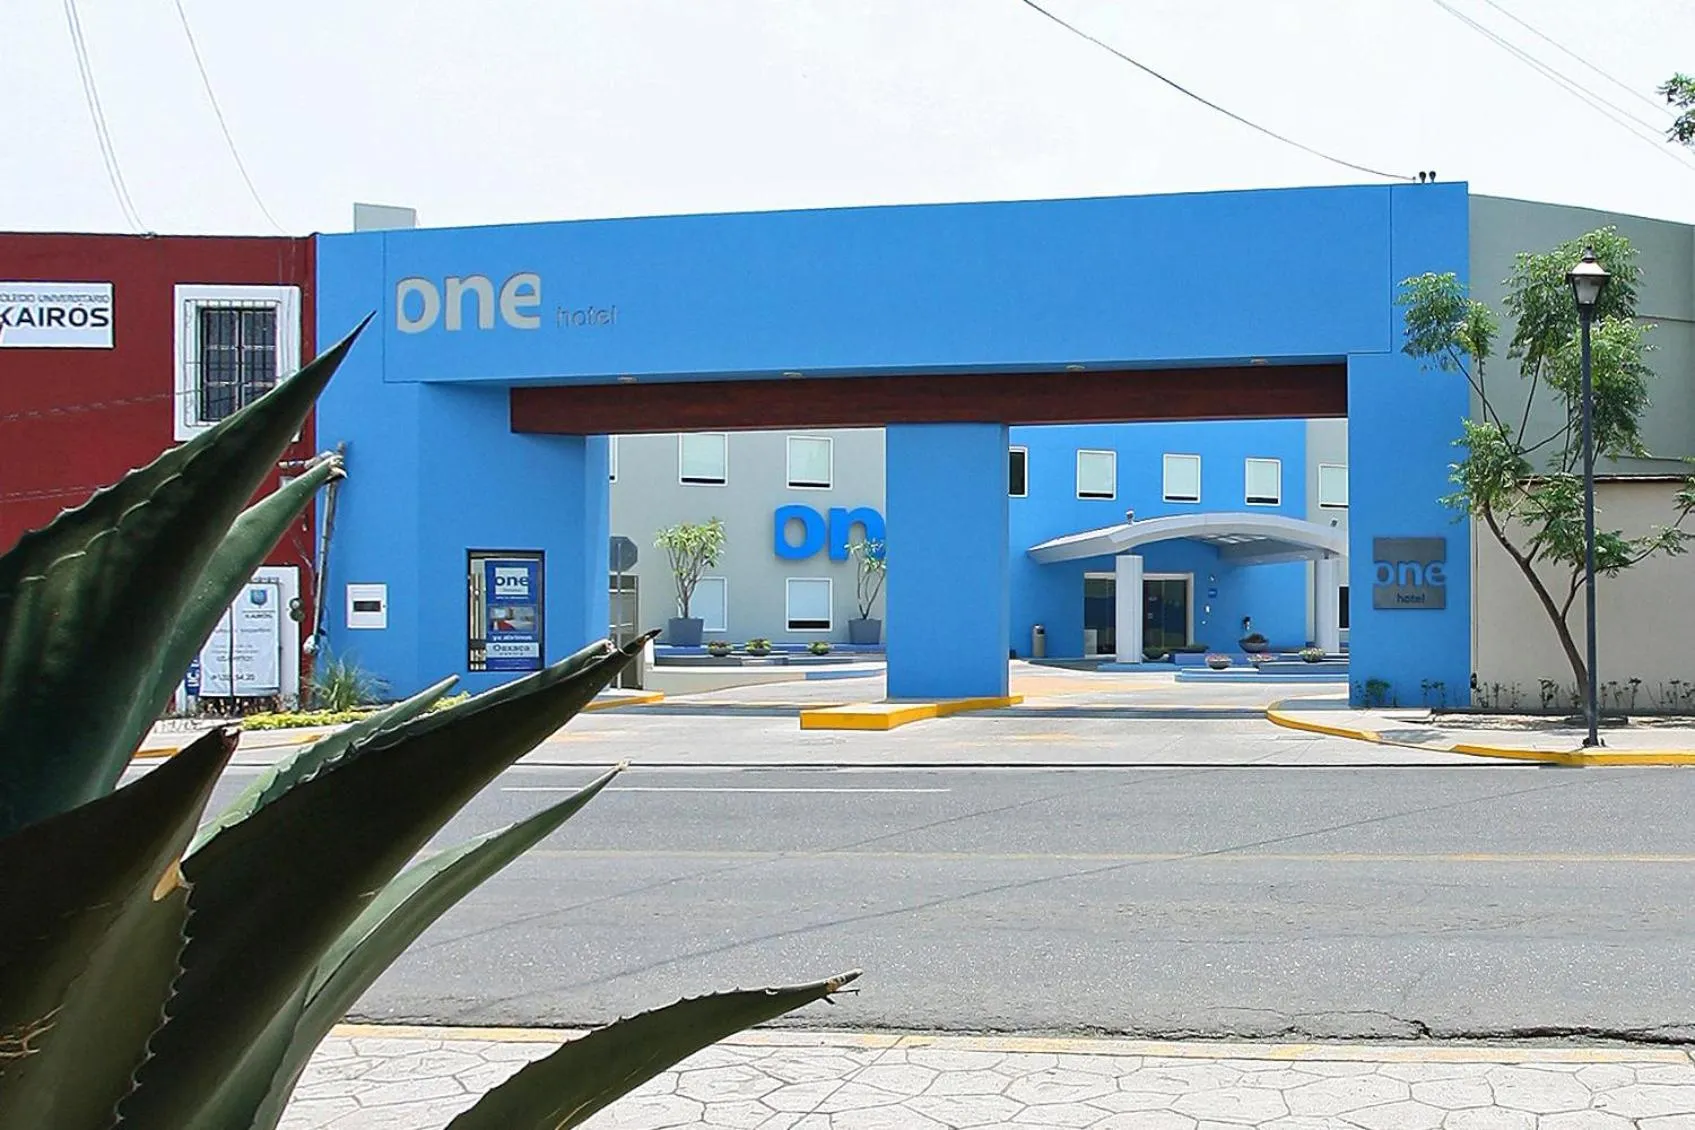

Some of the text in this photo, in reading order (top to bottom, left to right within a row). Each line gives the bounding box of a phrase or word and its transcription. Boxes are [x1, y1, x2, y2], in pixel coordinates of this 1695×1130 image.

[395, 271, 542, 334] one
[556, 304, 619, 328] hotel
[774, 504, 886, 564] on
[495, 575, 528, 586] one
[1373, 560, 1447, 588] one
[1397, 592, 1425, 604] hotel
[492, 644, 530, 652] Oaxaca
